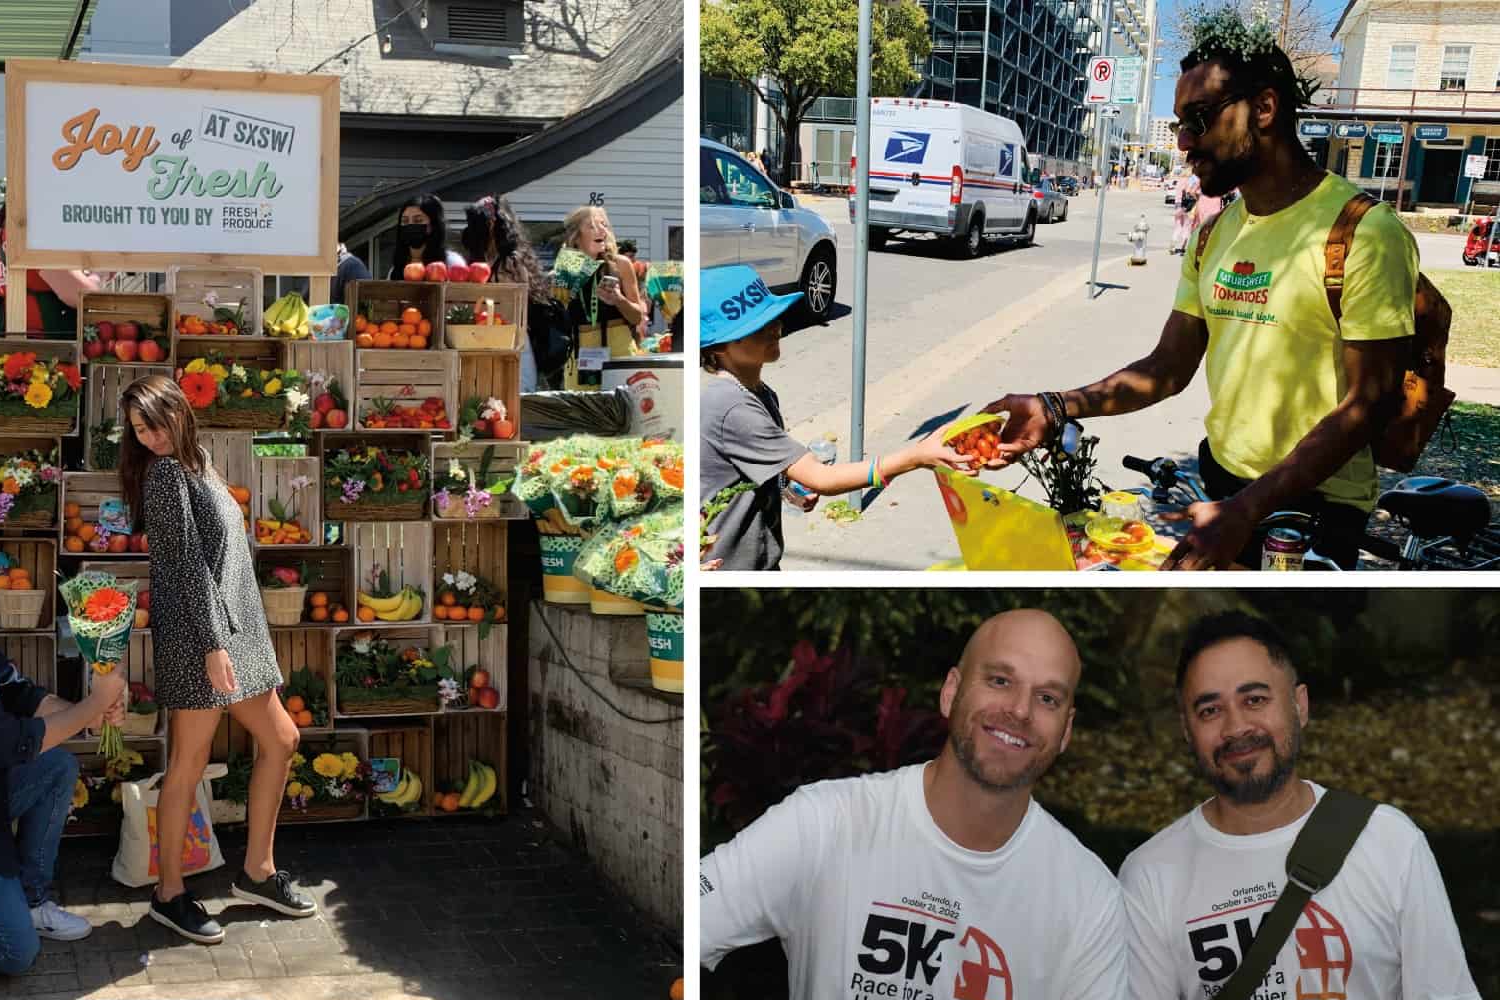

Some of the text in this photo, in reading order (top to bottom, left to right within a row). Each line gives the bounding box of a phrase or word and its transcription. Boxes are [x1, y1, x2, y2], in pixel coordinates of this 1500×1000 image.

[52, 108, 193, 172] Joy of
[204, 114, 290, 153] AT SXSW
[148, 155, 284, 200] Fresh
[589, 192, 605, 207] 85
[62, 204, 213, 226] BROUGHT TO YOU BY
[222, 206, 258, 217] FRESH
[222, 218, 274, 229] PRODUCE
[1213, 283, 1269, 304] TOMATOES
[542, 556, 565, 568] ESH
[1267, 881, 1276, 889] FL
[857, 913, 955, 986] 5K
[850, 973, 898, 997] Race
[902, 980, 922, 1000] for
[1275, 971, 1285, 984] a
